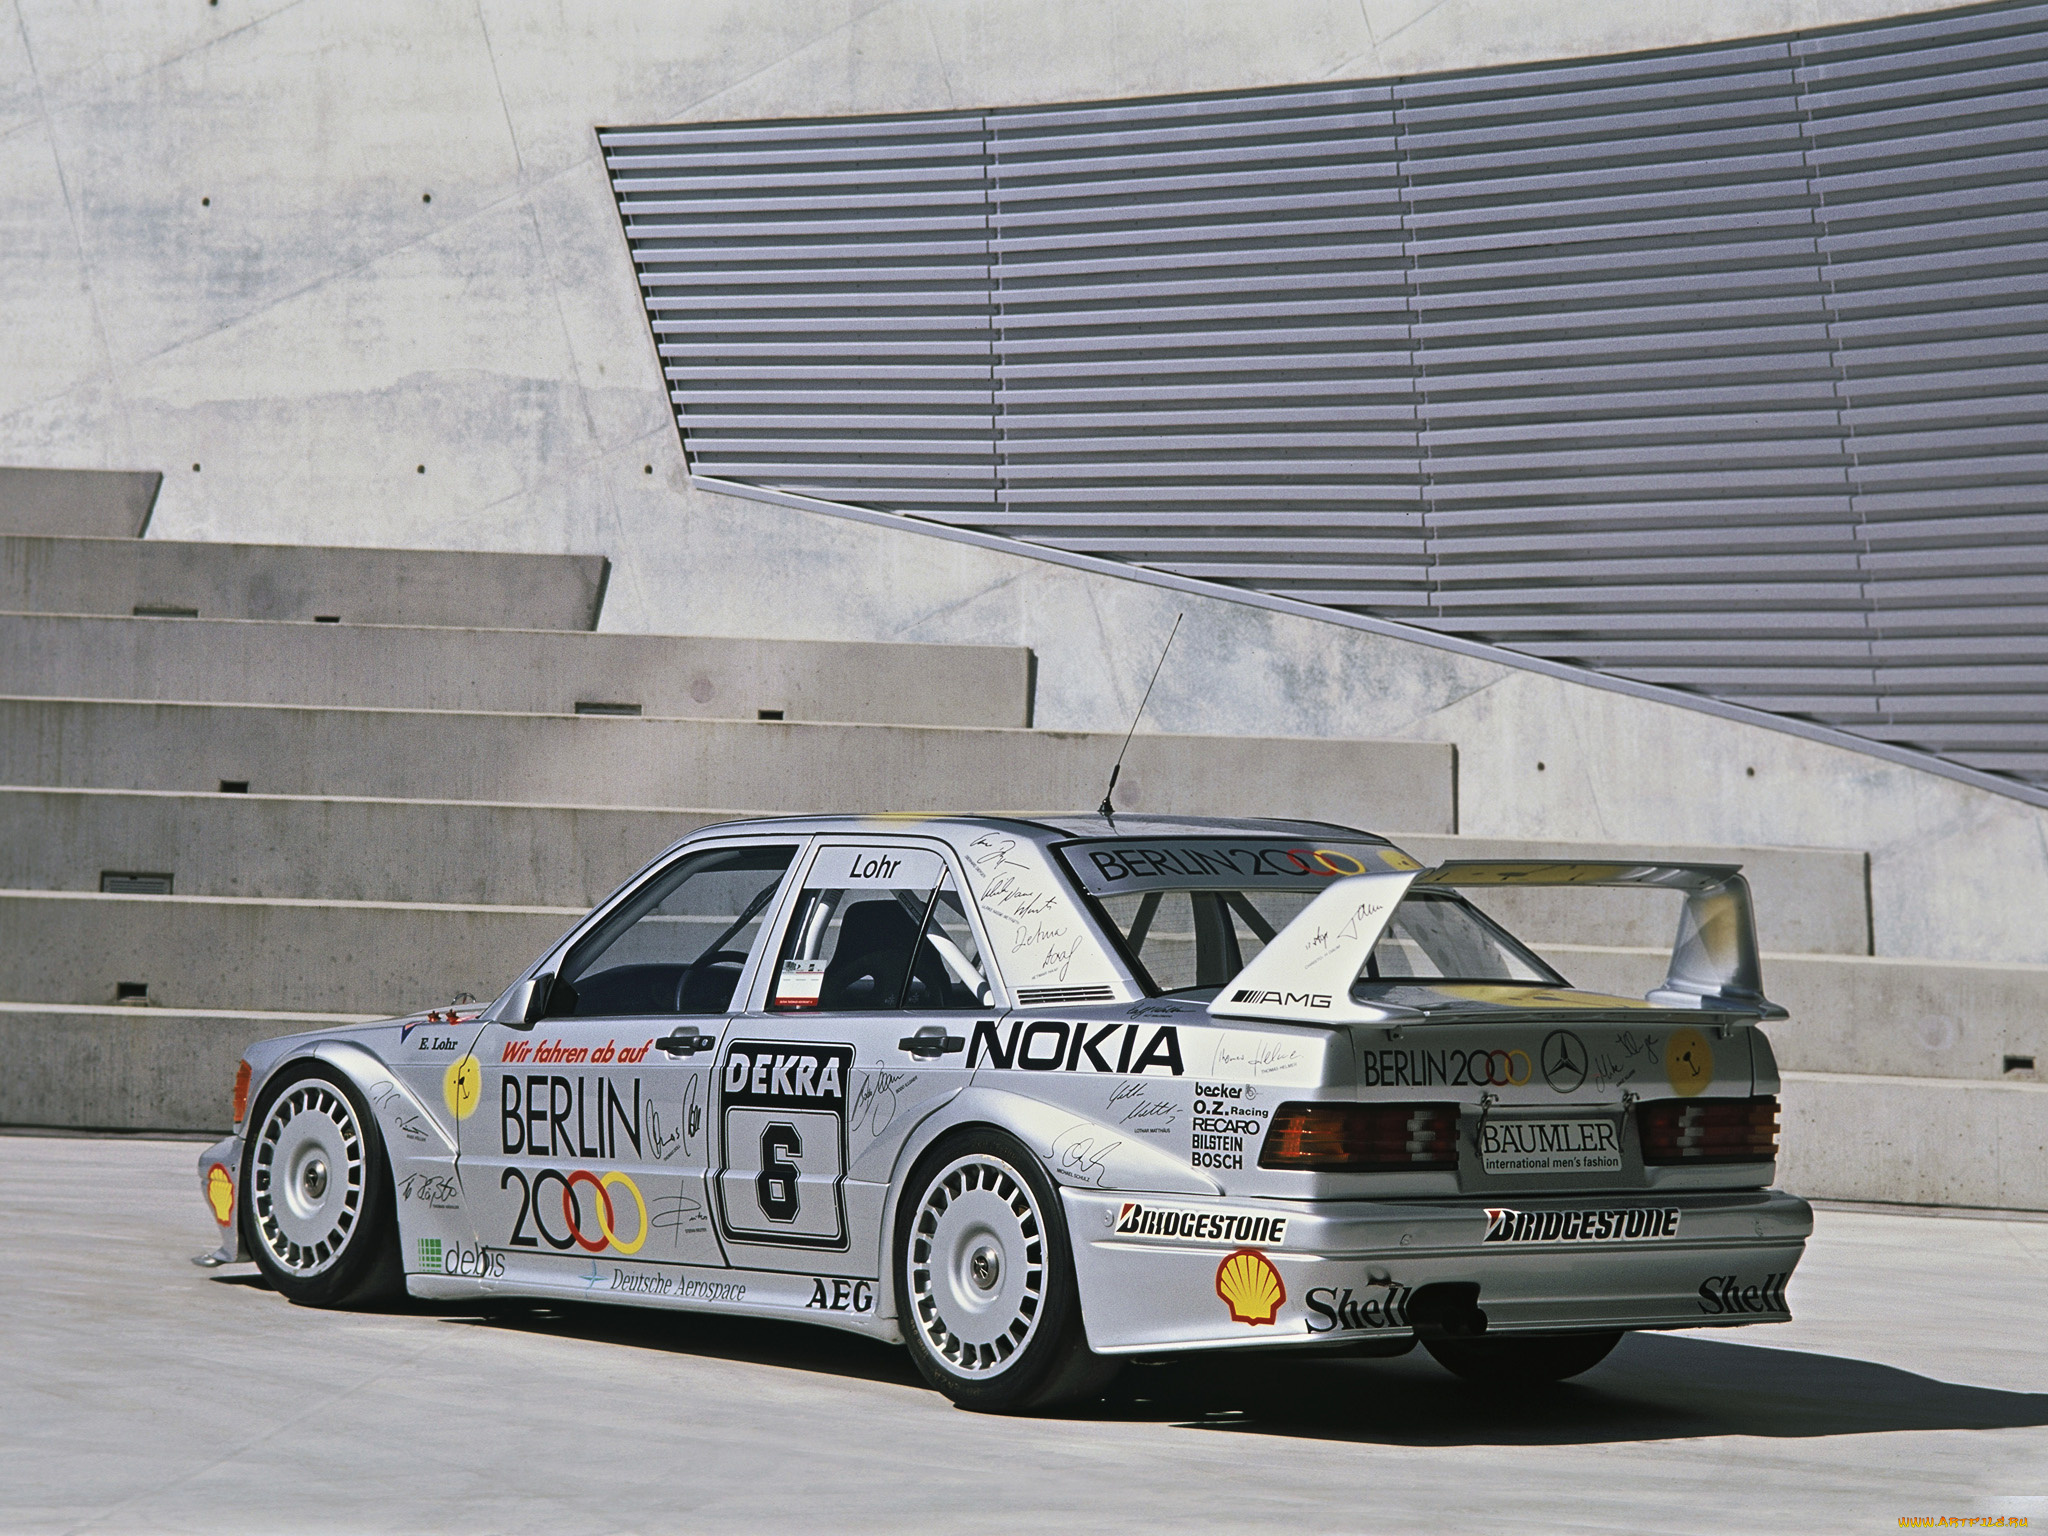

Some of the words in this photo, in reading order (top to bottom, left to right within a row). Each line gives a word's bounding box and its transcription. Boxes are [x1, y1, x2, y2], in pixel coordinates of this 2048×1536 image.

[850, 854, 901, 878] Lohr
[1089, 849, 1243, 882] BERLIN
[1260, 991, 1332, 1008] AMG
[419, 1037, 430, 1050] E.
[431, 1037, 458, 1050] Lohr
[501, 1039, 532, 1063] Wir
[532, 1038, 589, 1063] fahren
[590, 1039, 616, 1063] ab
[617, 1038, 654, 1063] auf
[966, 1020, 1185, 1076] NOKIA
[725, 1053, 842, 1098] DEKRA
[1364, 1050, 1447, 1087] BERLIN
[1449, 1049, 1532, 1087] 2000
[1195, 1081, 1242, 1098] becker
[502, 1074, 642, 1160] BERLIN
[1192, 1117, 1260, 1135] RECARO
[1193, 1100, 1229, 1115] O.Z.
[1231, 1106, 1269, 1118] Racing
[1192, 1134, 1243, 1152] BILSTEIN
[1484, 1123, 1618, 1153] BÄUMLER
[755, 1121, 803, 1224] 6
[1192, 1152, 1243, 1170] BOSCH
[1486, 1158, 1550, 1169] international
[1552, 1157, 1581, 1168] men's
[1583, 1156, 1619, 1167] fashion
[501, 1166, 648, 1255] 2000
[1116, 1203, 1287, 1242] BRIDGESTONE
[1484, 1208, 1679, 1242] BRIDGESTONE
[445, 1241, 506, 1278] debis
[610, 1268, 673, 1295] Deutsche
[674, 1275, 747, 1302] Aerospace
[806, 1278, 873, 1312] AEG
[1698, 1272, 1788, 1315] Shell
[1305, 1286, 1413, 1334] Shell
